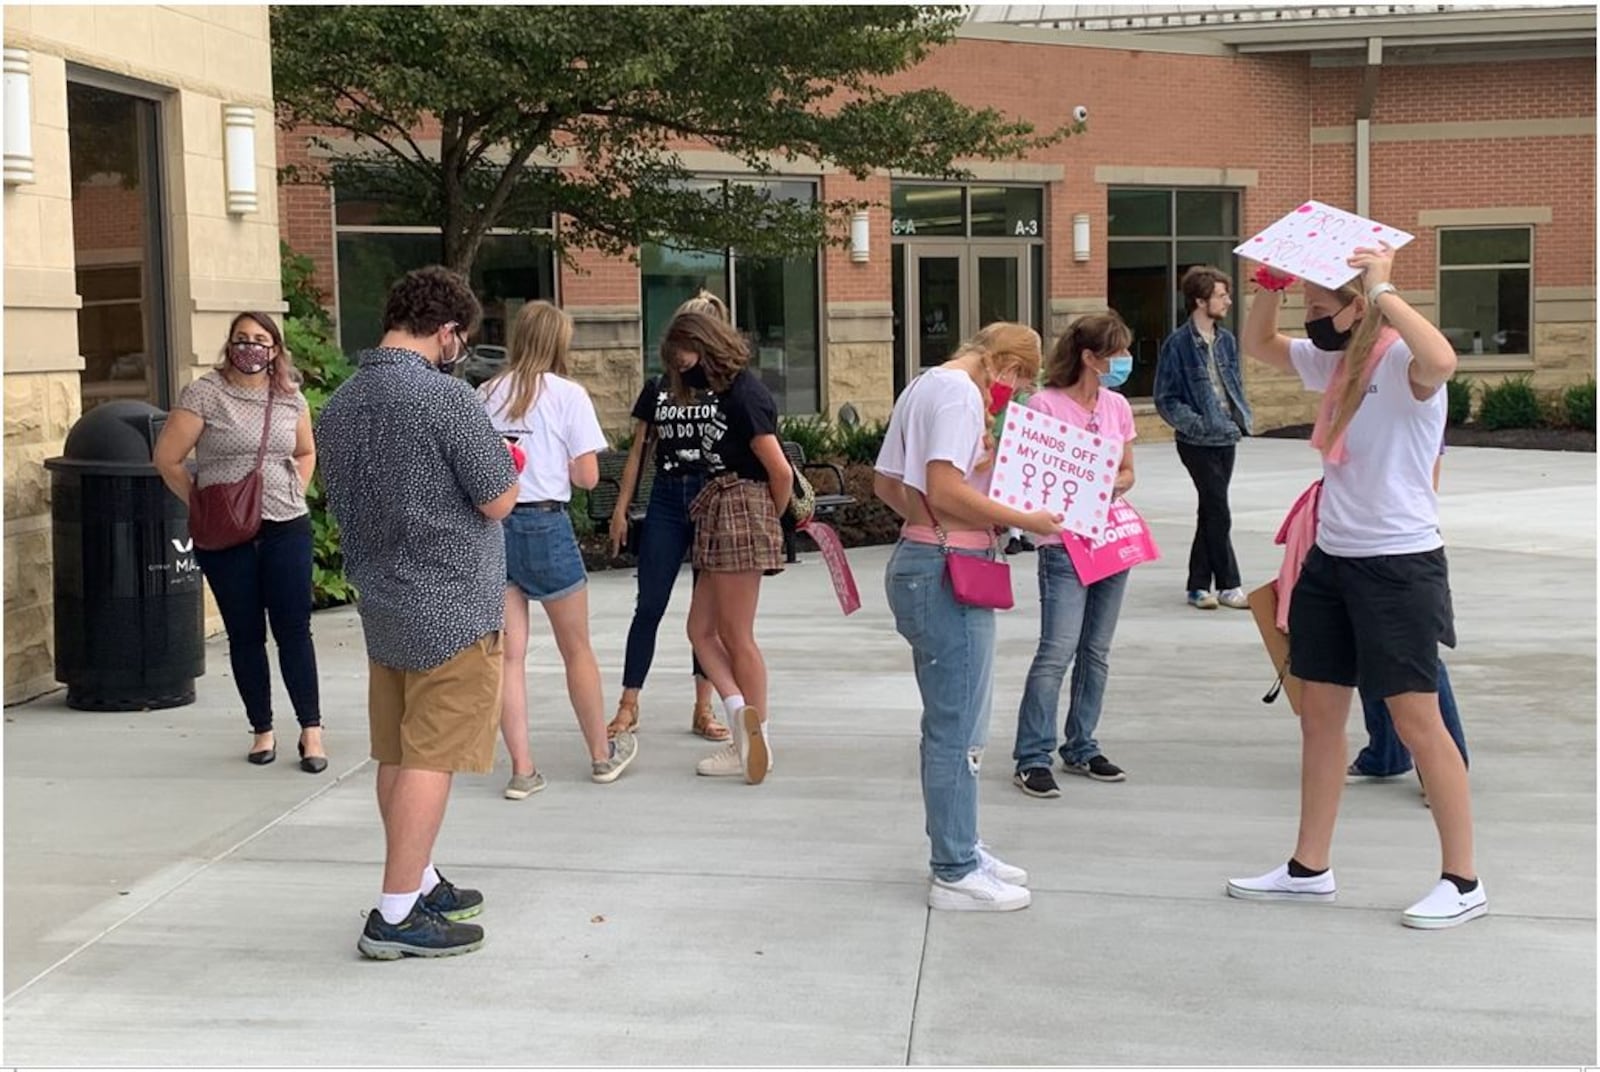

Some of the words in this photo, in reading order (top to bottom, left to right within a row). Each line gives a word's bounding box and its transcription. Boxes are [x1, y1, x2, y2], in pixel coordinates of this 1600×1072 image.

[1014, 220, 1037, 235] A-3
[677, 423, 694, 438] DO
[1021, 426, 1066, 453] HANDS
[1071, 447, 1098, 464] OFF
[1016, 443, 1039, 460] MY
[1042, 452, 1095, 482] UTERUS
